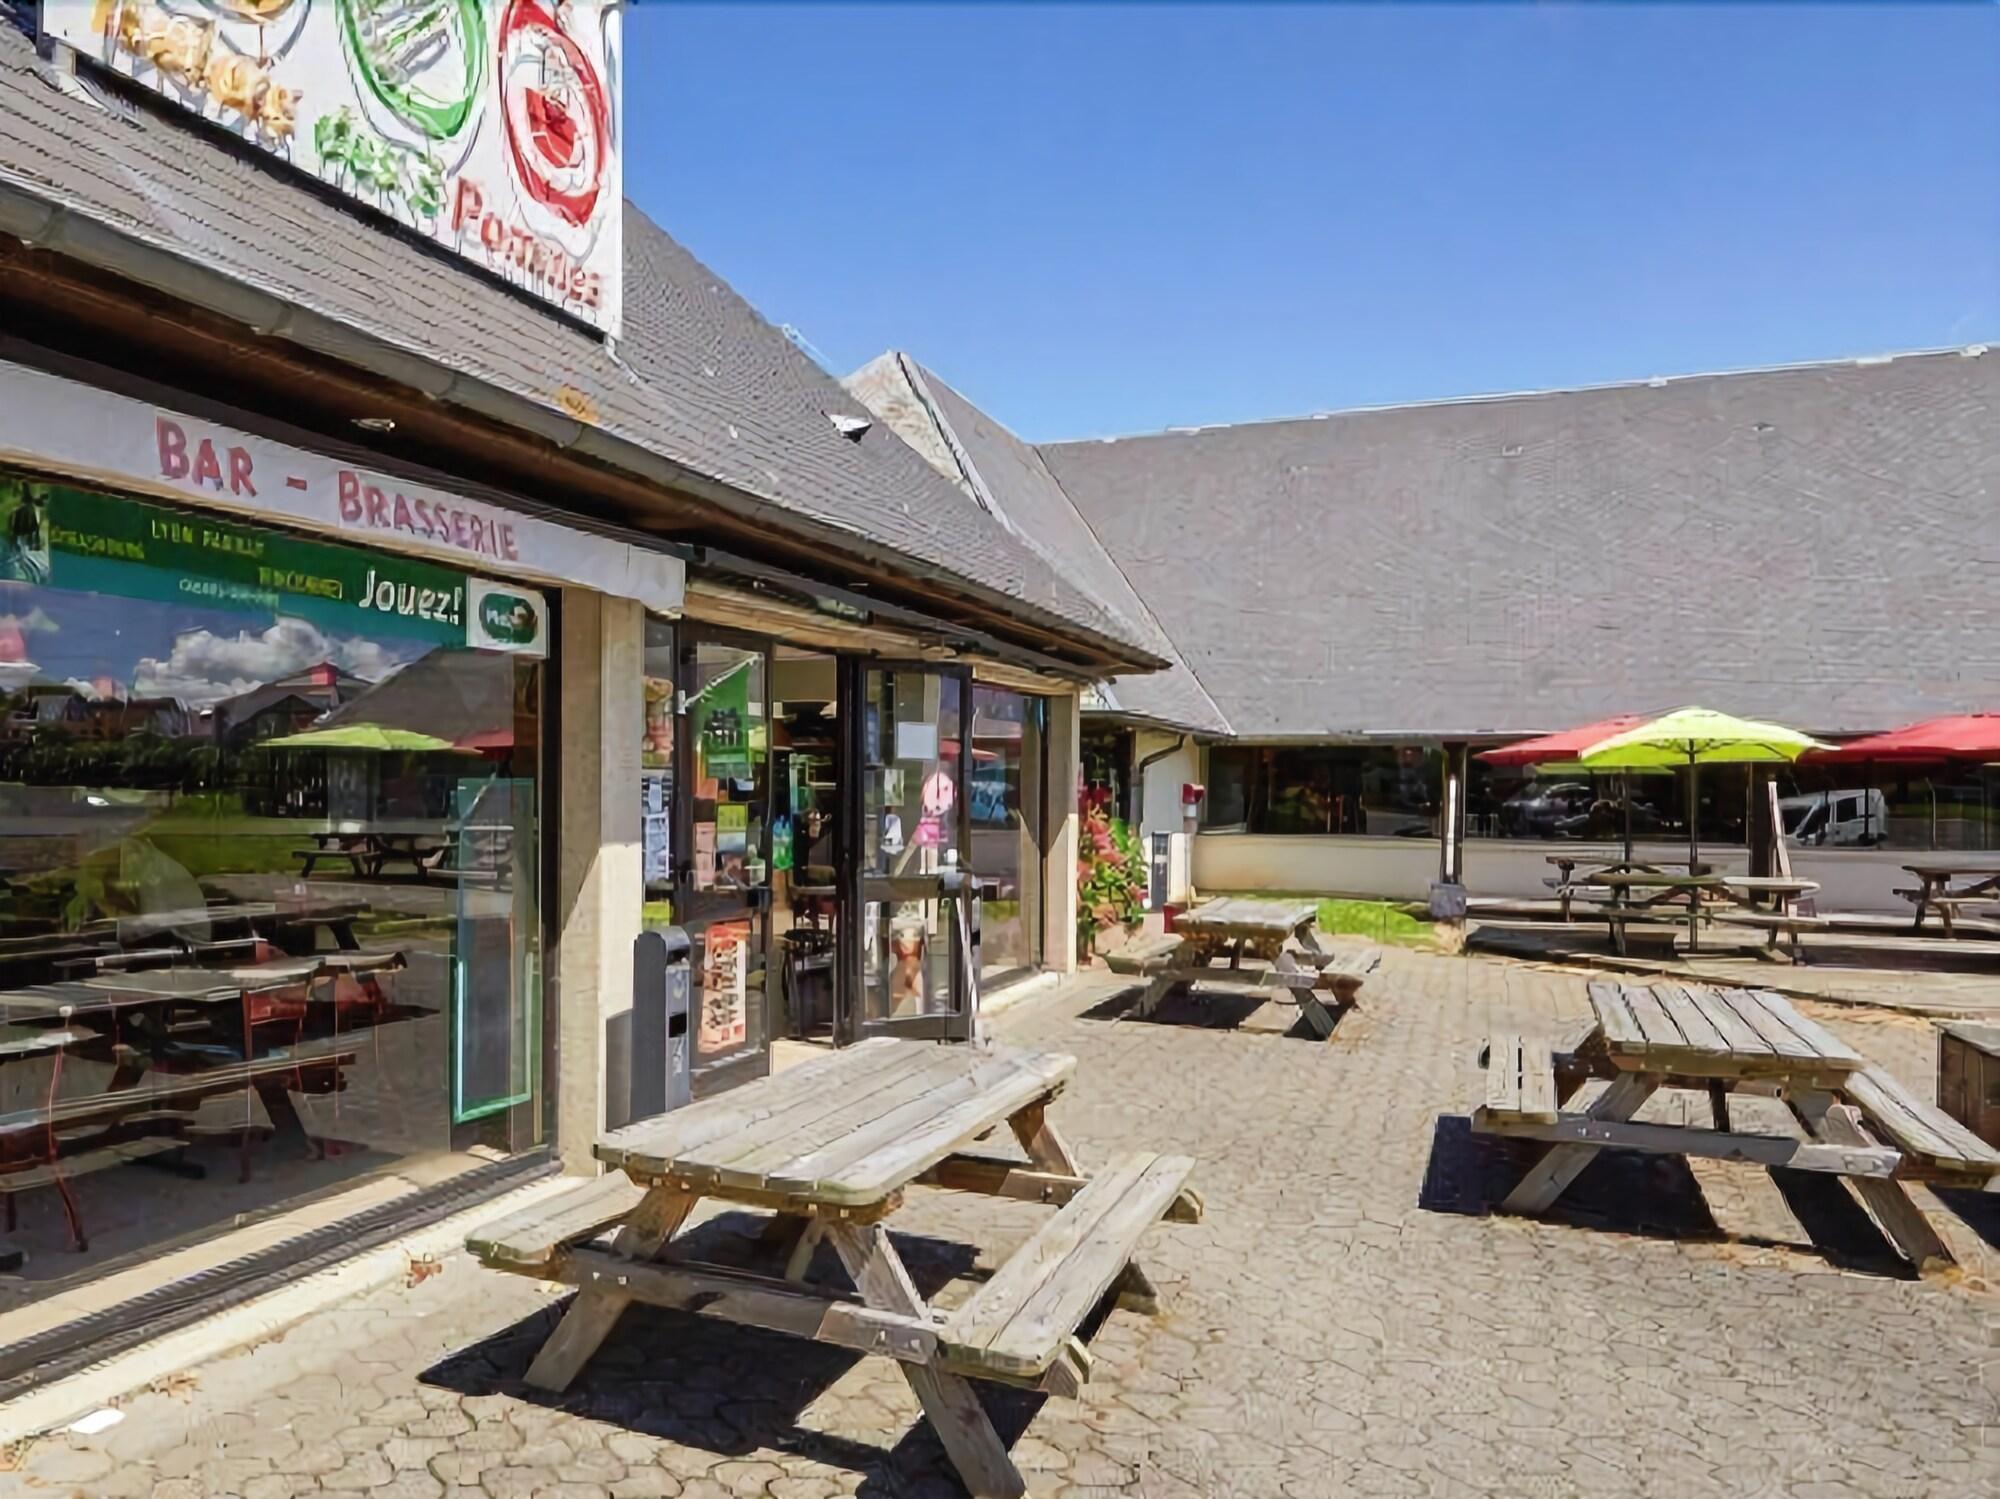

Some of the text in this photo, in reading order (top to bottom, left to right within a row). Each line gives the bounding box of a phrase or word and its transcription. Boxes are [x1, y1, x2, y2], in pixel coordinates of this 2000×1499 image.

[156, 416, 257, 497] BAR
[339, 470, 518, 561] BRASSERIE
[358, 567, 463, 626] Jouez!
